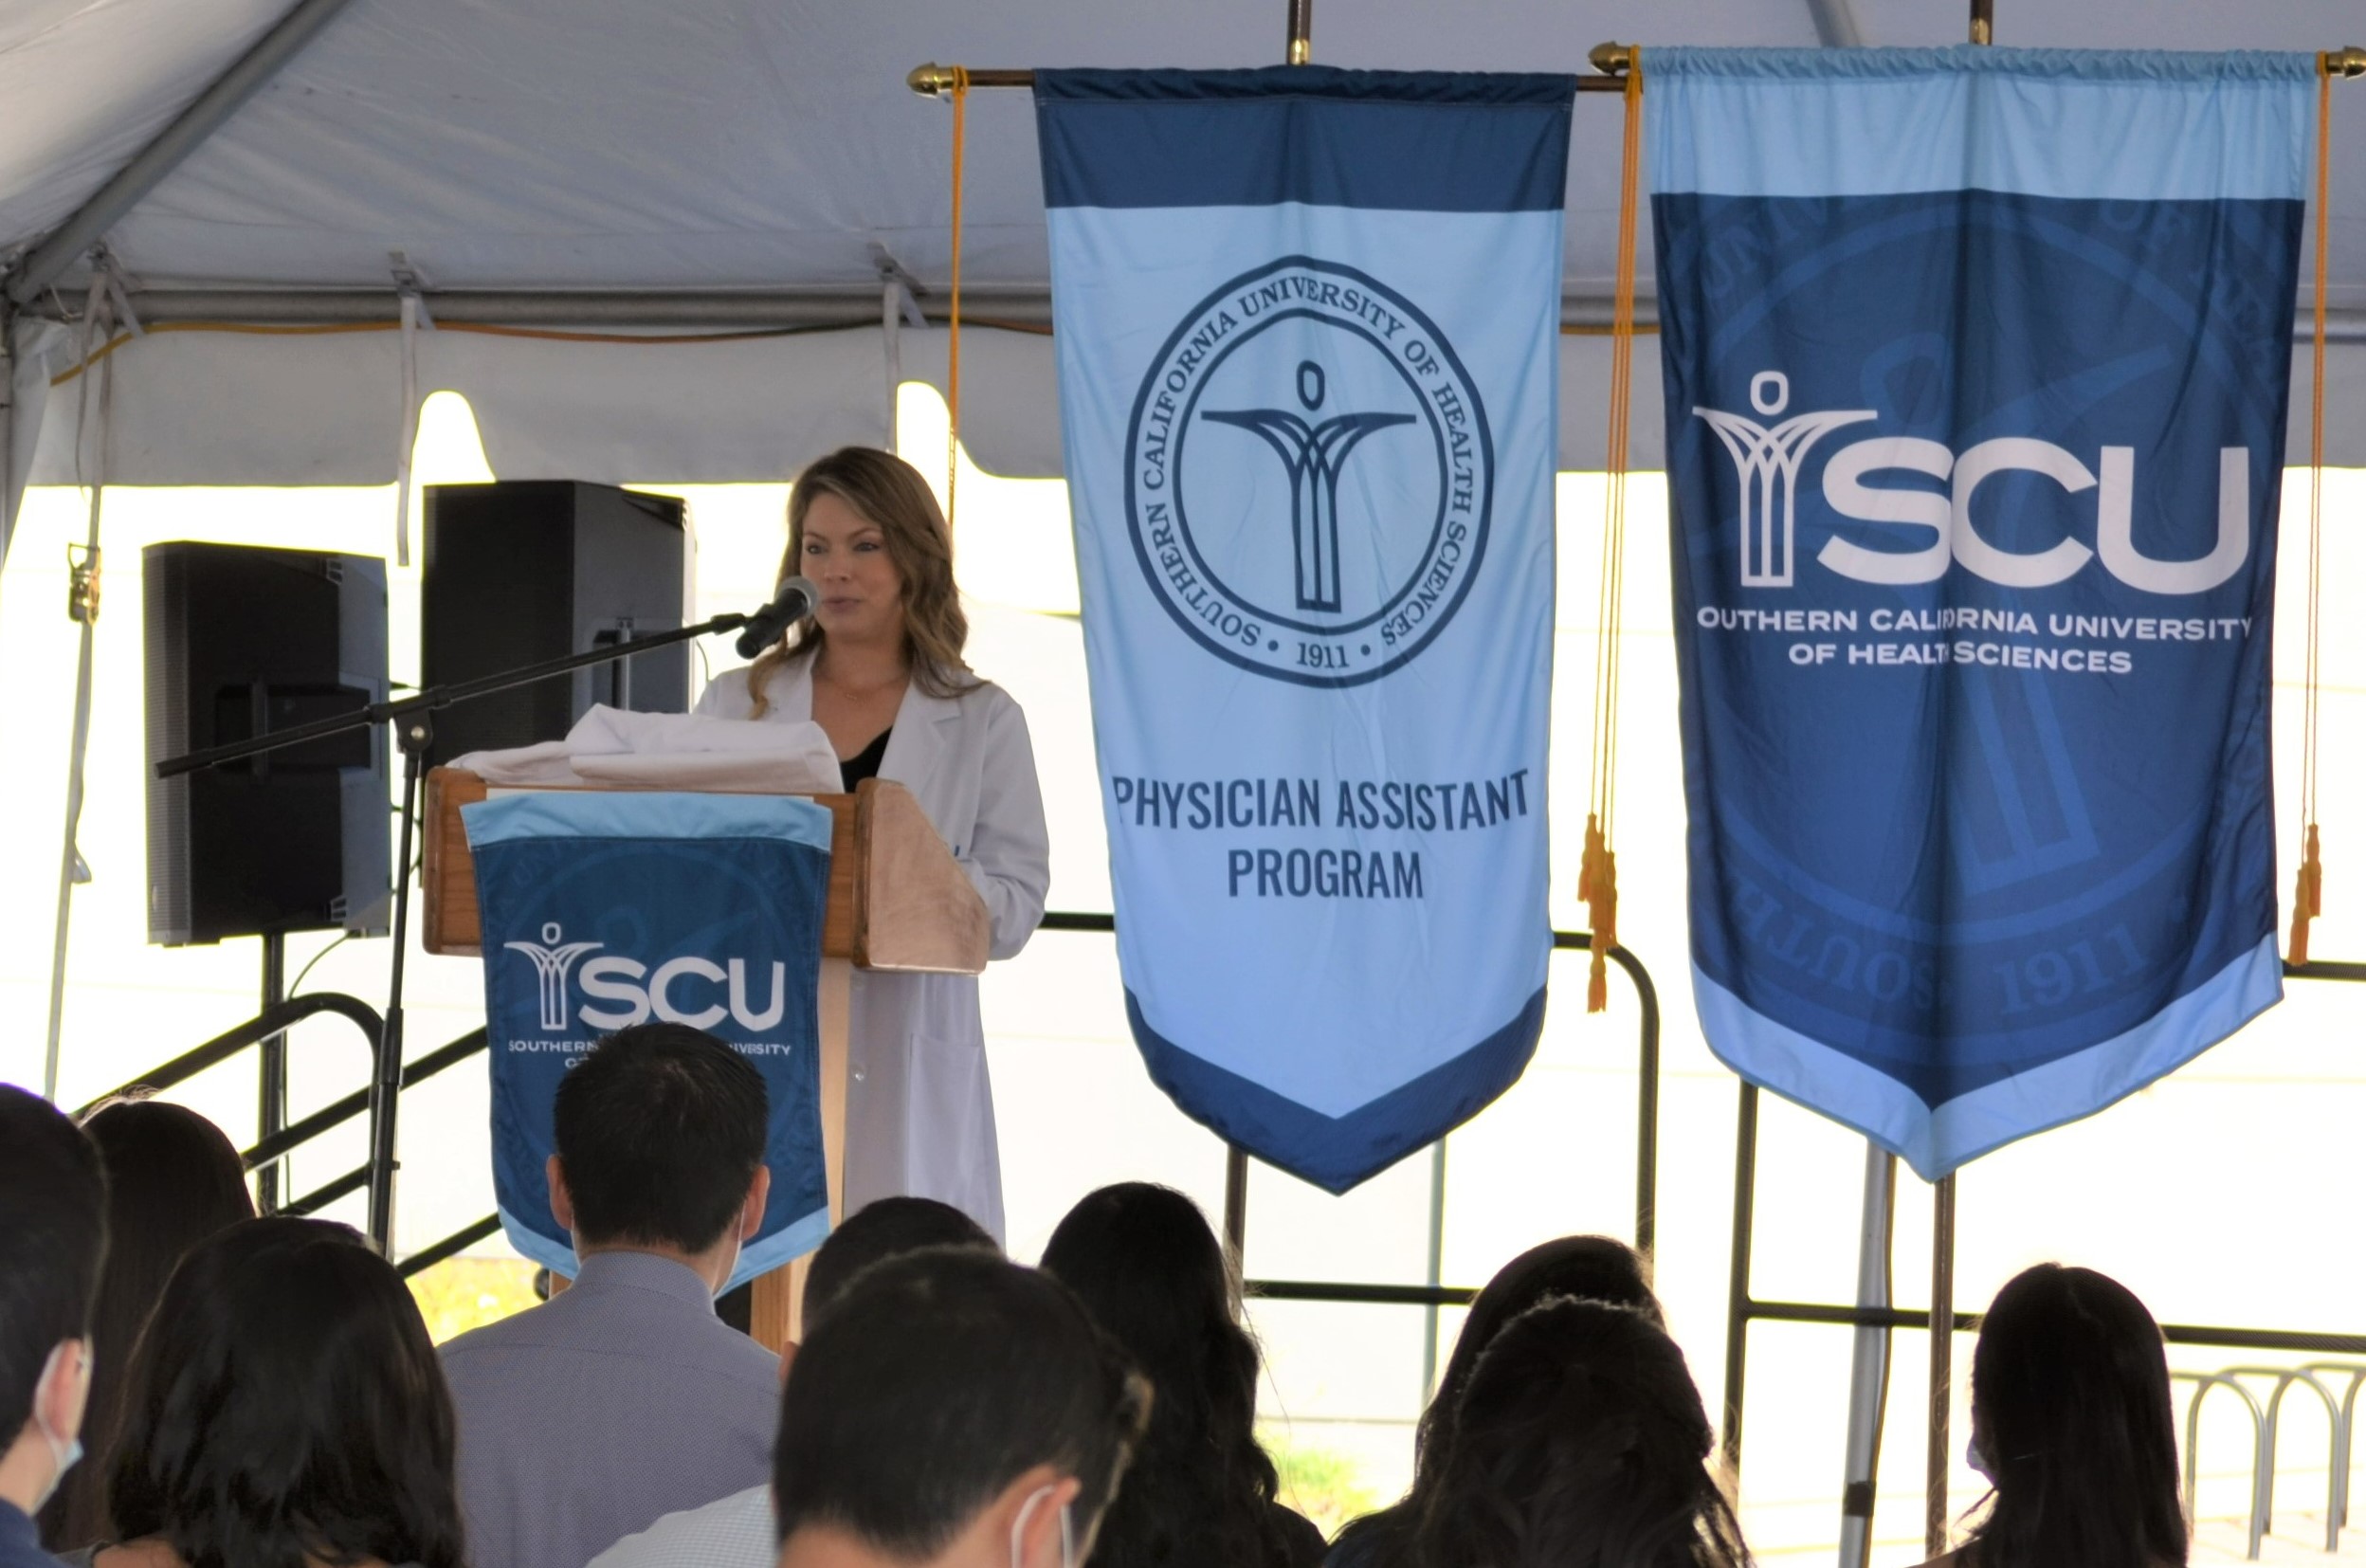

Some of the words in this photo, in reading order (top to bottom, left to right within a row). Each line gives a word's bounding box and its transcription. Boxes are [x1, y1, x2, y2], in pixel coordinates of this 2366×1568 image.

[1239, 276, 1406, 339] UNIVERSITY
[1404, 338, 1440, 378] OF
[1143, 310, 1238, 490] CALIFORNIA
[1432, 383, 1474, 515] HEALTH
[1816, 436, 2249, 595] SCU
[1148, 501, 1263, 648] SOUTHERN
[1381, 523, 1468, 647] SCIENCES
[1296, 642, 1350, 669] 1911
[1697, 606, 1858, 632] OUTHERN
[2048, 612, 2252, 642] UNIVERSITY
[1788, 642, 1838, 665] OF
[1953, 640, 2133, 674] SCIENCES
[1112, 775, 1321, 830] PHYSICIAN
[1336, 768, 1529, 832] ASSISTANT
[1228, 848, 1424, 899] PROGRAM
[578, 956, 786, 1031] SCU
[1993, 921, 2149, 1015] 1911
